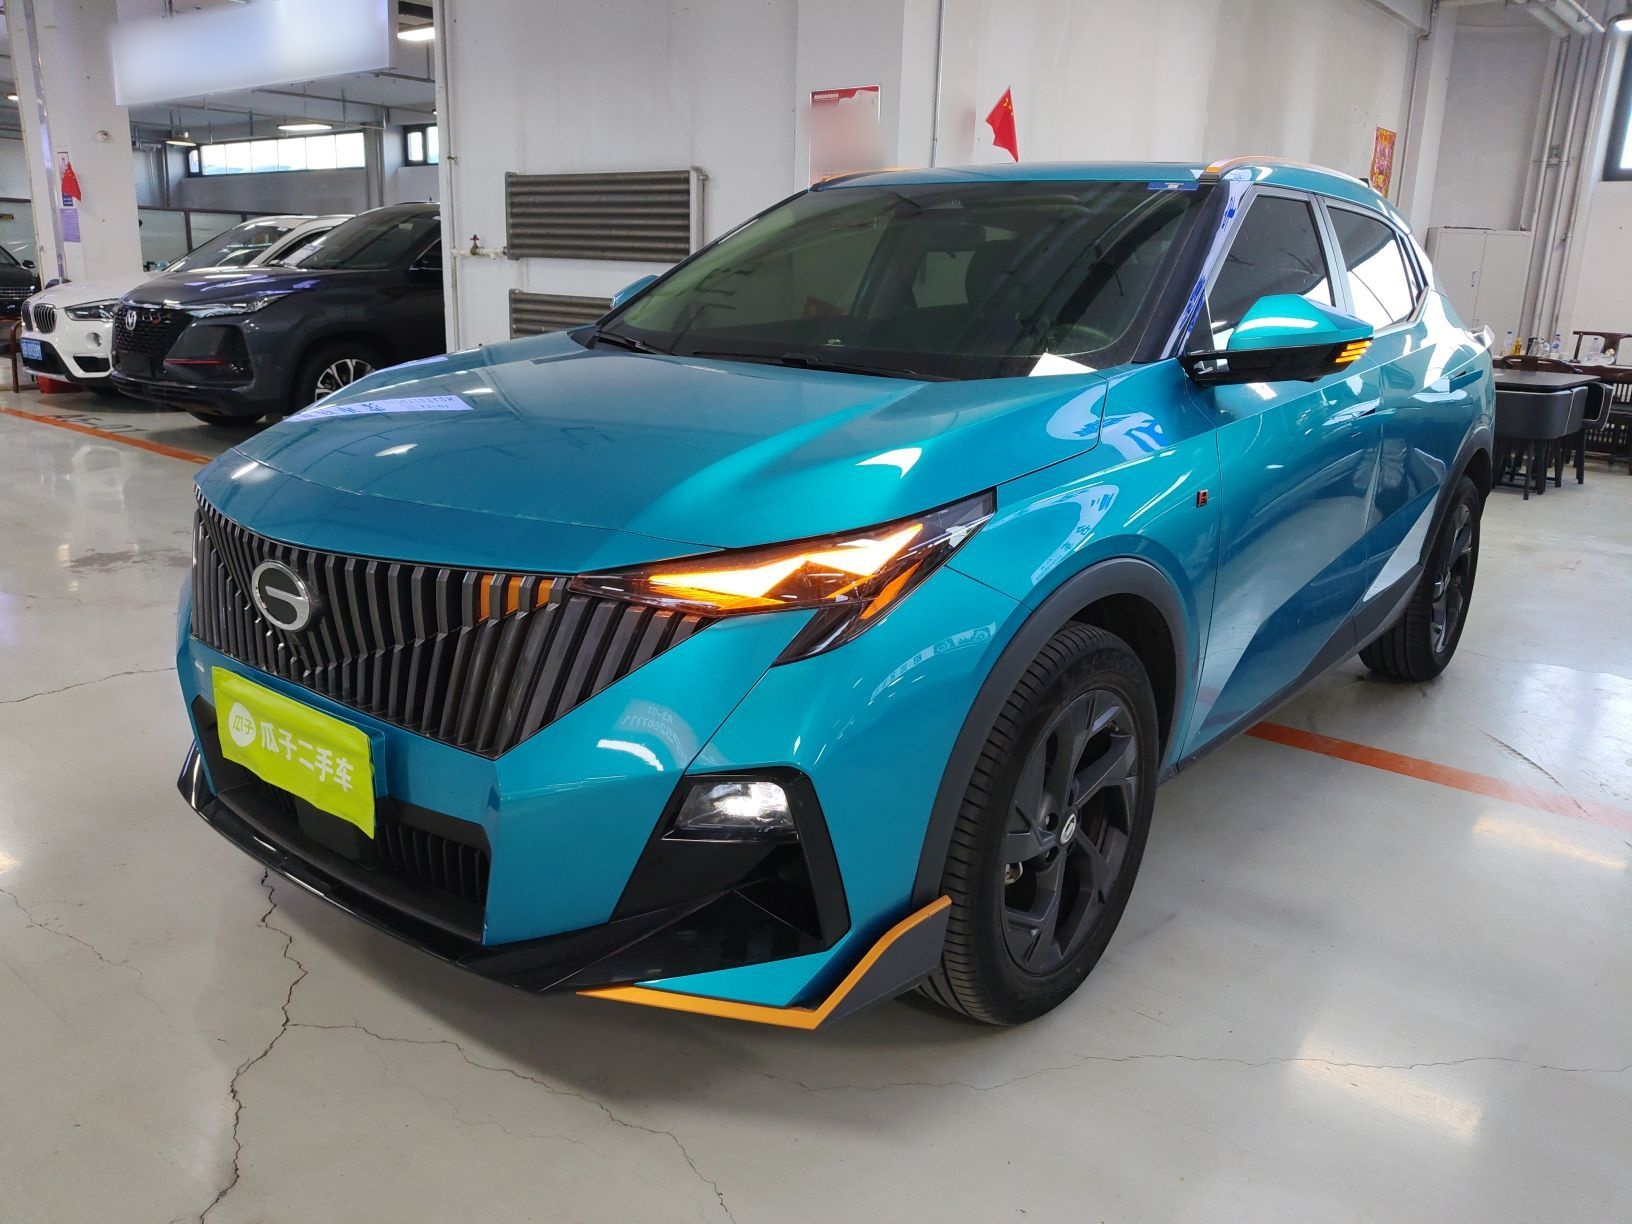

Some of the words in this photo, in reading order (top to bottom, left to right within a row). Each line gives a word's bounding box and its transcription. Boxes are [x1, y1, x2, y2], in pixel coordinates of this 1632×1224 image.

[233, 714, 254, 735] 瓜子
[261, 722, 353, 792] 瓜子二手车
